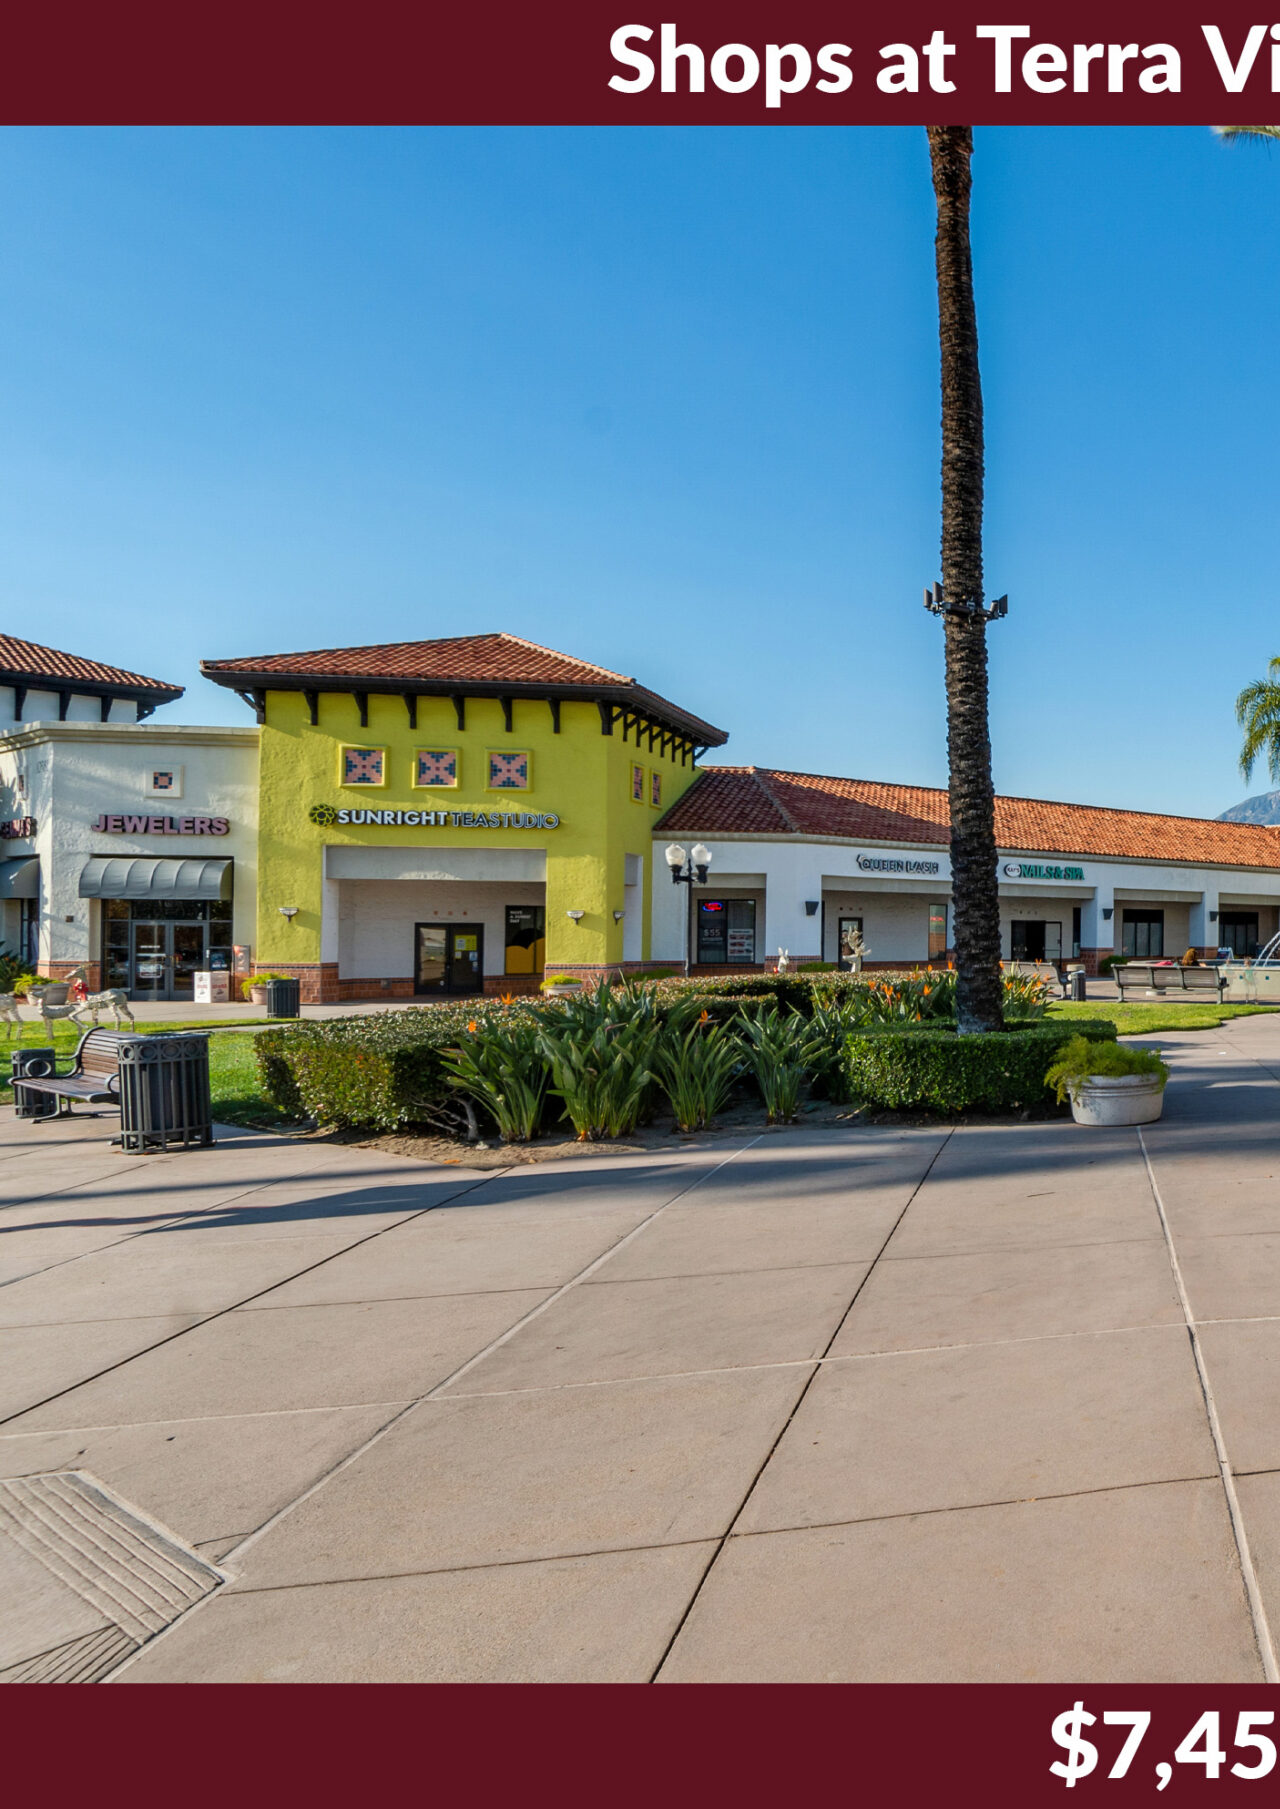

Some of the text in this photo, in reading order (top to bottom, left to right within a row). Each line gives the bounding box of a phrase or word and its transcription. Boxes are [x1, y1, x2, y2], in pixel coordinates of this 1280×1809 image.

[91, 814, 231, 836] JEWELERS
[338, 809, 447, 826] SUNRIGHT
[862, 858, 939, 874] QUEEN LASH
[1021, 864, 1053, 879] NAILS
[1064, 867, 1085, 880] SPA
